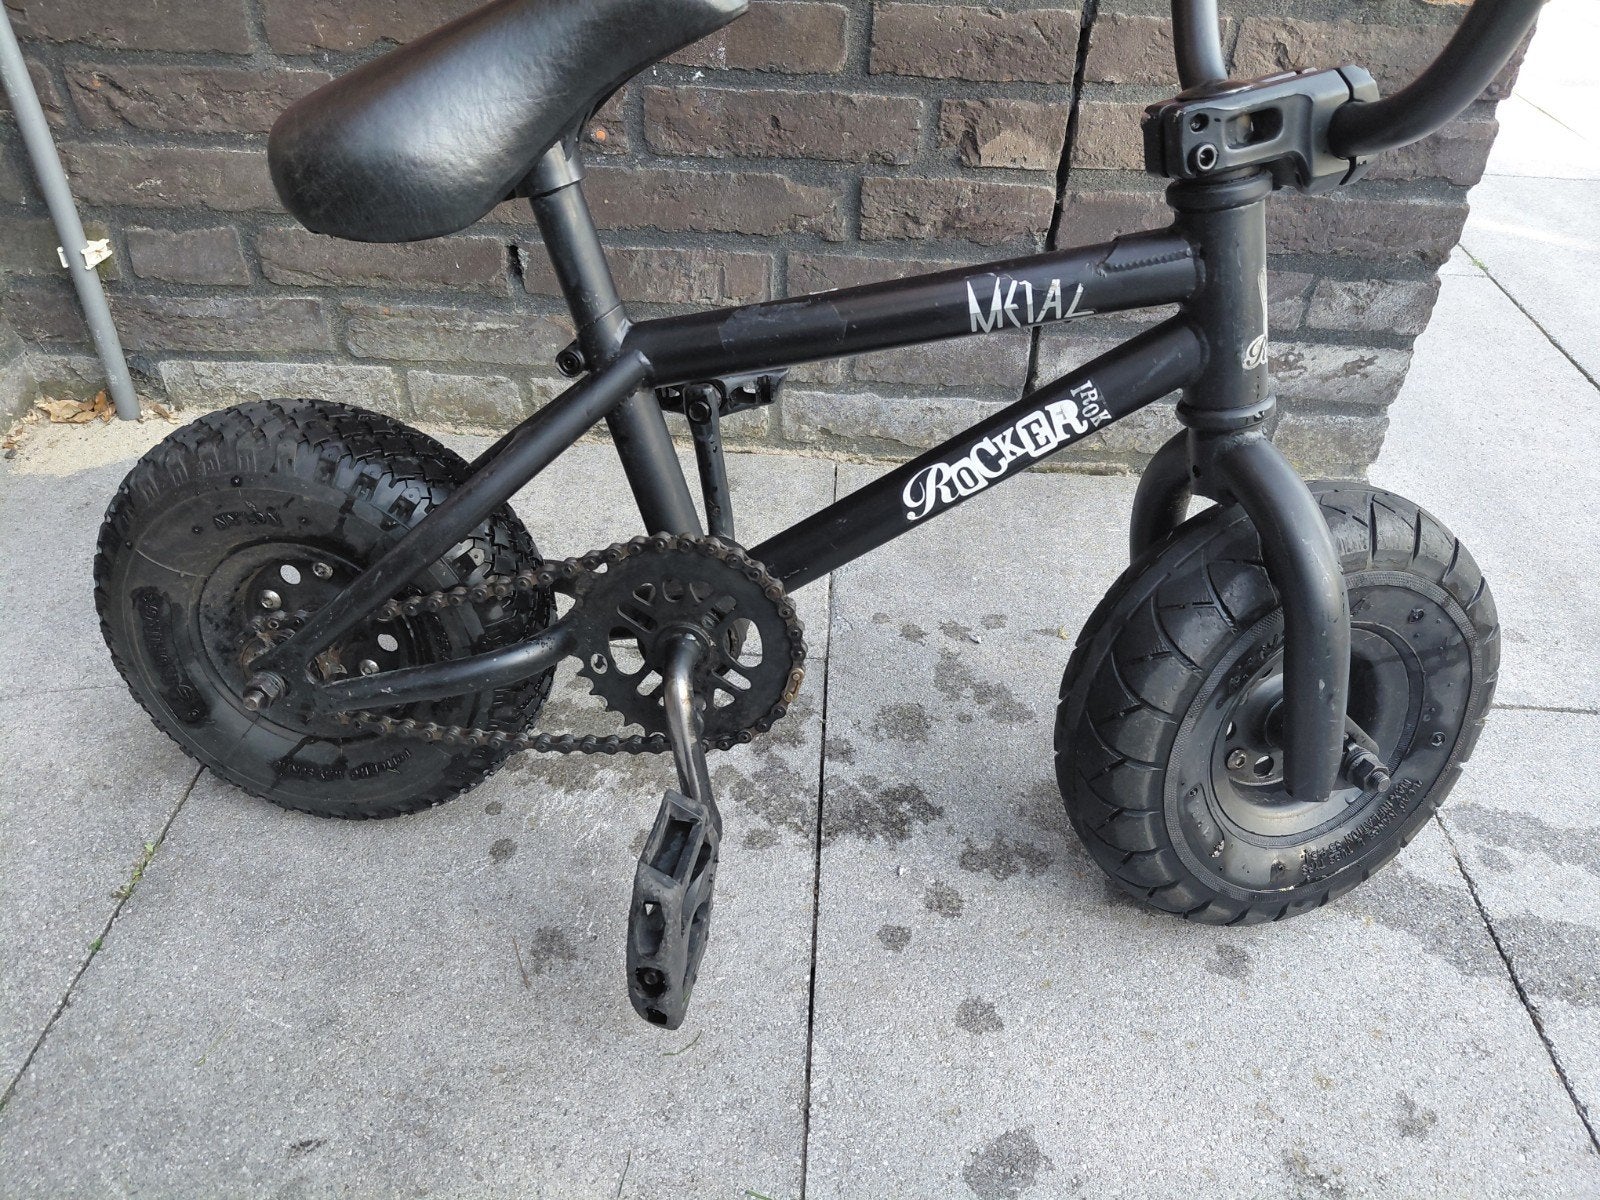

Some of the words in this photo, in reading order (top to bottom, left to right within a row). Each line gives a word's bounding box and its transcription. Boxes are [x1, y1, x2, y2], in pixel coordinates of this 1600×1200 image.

[967, 277, 1095, 333] METAL
[1070, 380, 1112, 427] IROK
[902, 399, 1089, 520] ROCKER
